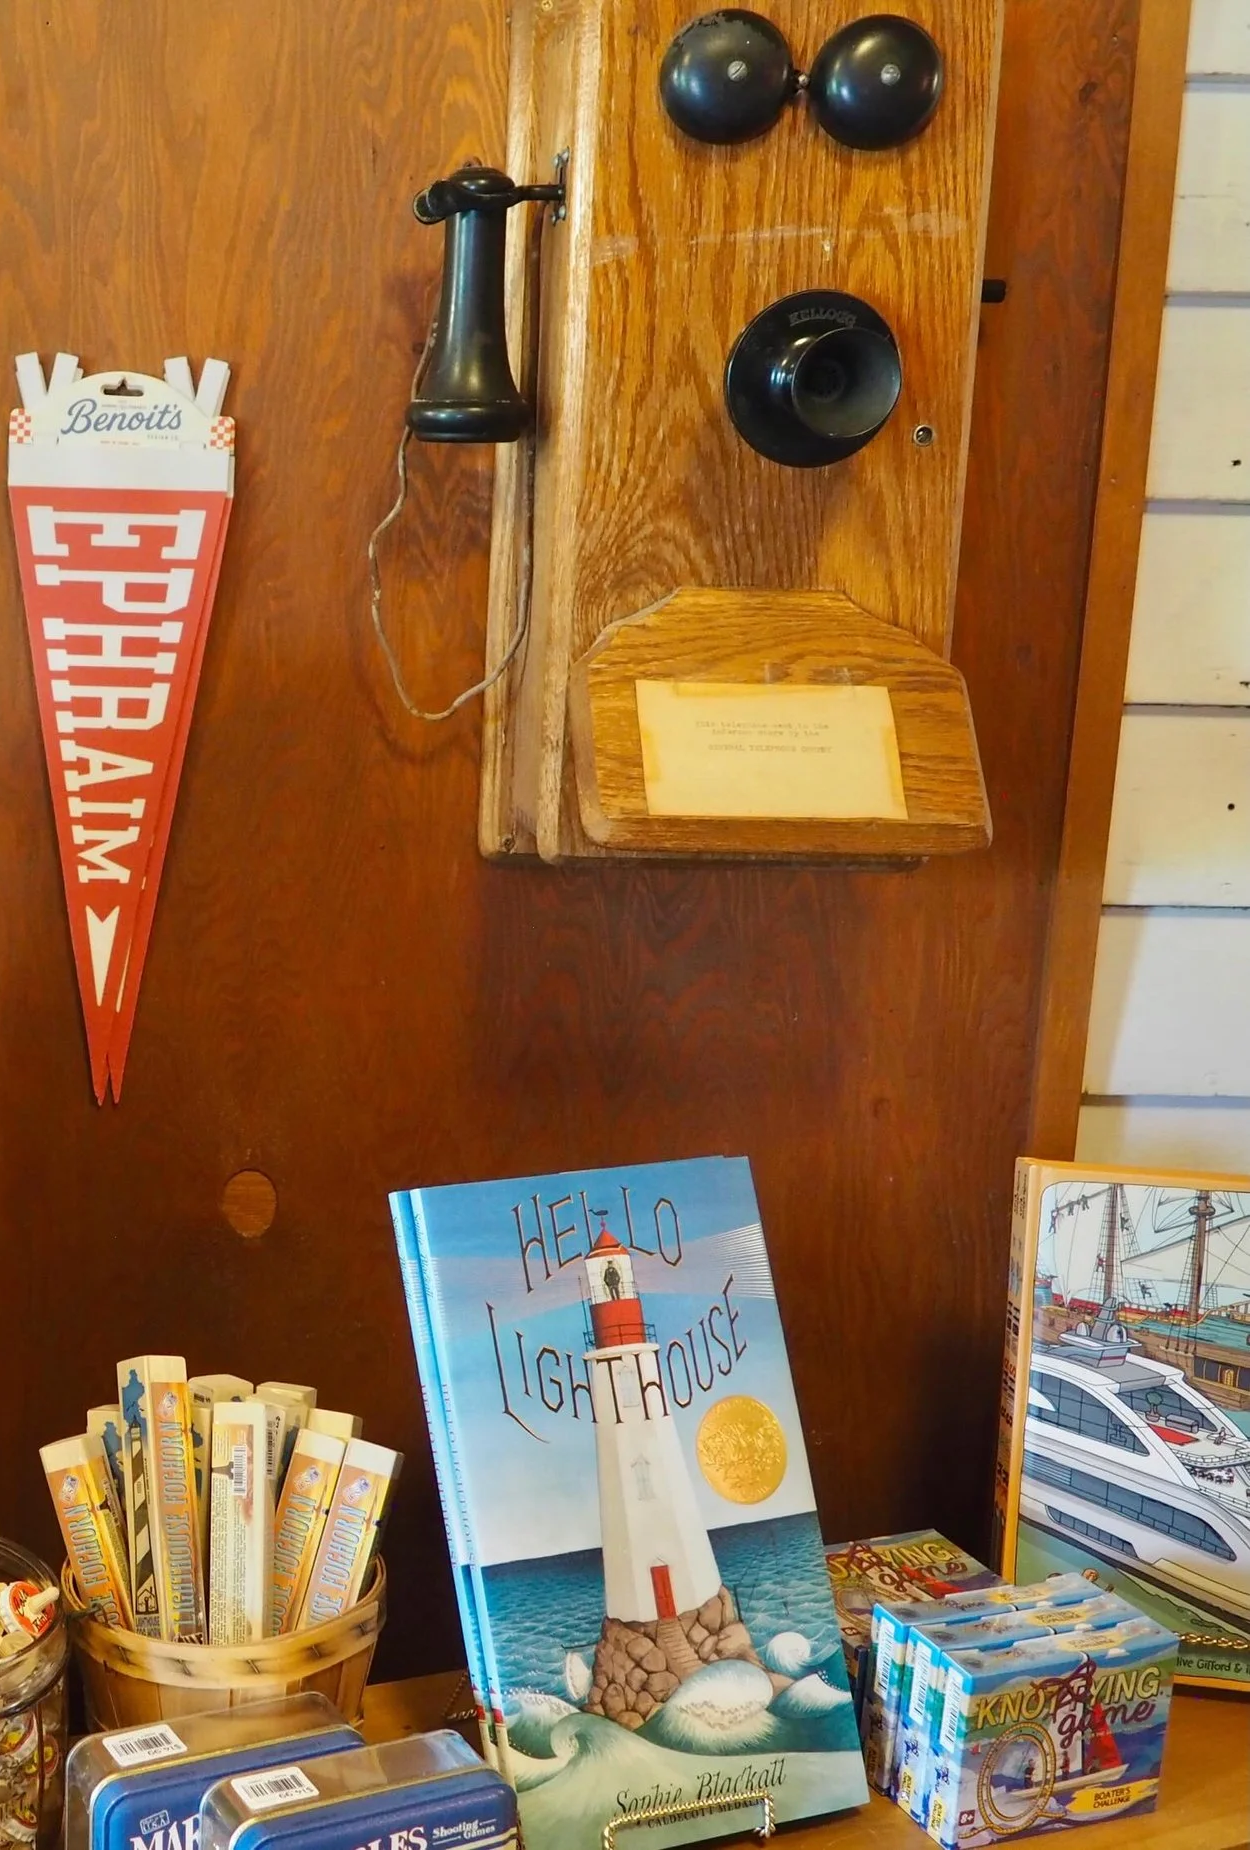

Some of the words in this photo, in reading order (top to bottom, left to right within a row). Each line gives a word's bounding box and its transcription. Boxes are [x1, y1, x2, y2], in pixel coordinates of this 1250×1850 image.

[60, 398, 183, 435] Benoit's
[26, 504, 207, 885] EPHRAIM
[511, 1184, 684, 1294] HELLO
[485, 1272, 748, 1444] LIGHTHOUSE
[162, 1419, 188, 1506] FOGHORN
[63, 1502, 111, 1590] FOGHORN
[321, 1503, 367, 1591] FOGHORN
[164, 1510, 196, 1628] LIGHTHOUSE
[1196, 1658, 1231, 1672] Gifford
[1233, 1662, 1243, 1673] &
[1057, 1699, 1158, 1750] game
[697, 1756, 787, 1801] Blackall
[1094, 1786, 1132, 1802] BOATER'S
[647, 1807, 715, 1829] CALDECOTT
[959, 1811, 975, 1824] 8+
[1092, 1796, 1132, 1810] CHALLENGE
[432, 1818, 480, 1839] Shooting
[463, 1824, 496, 1839] Games
